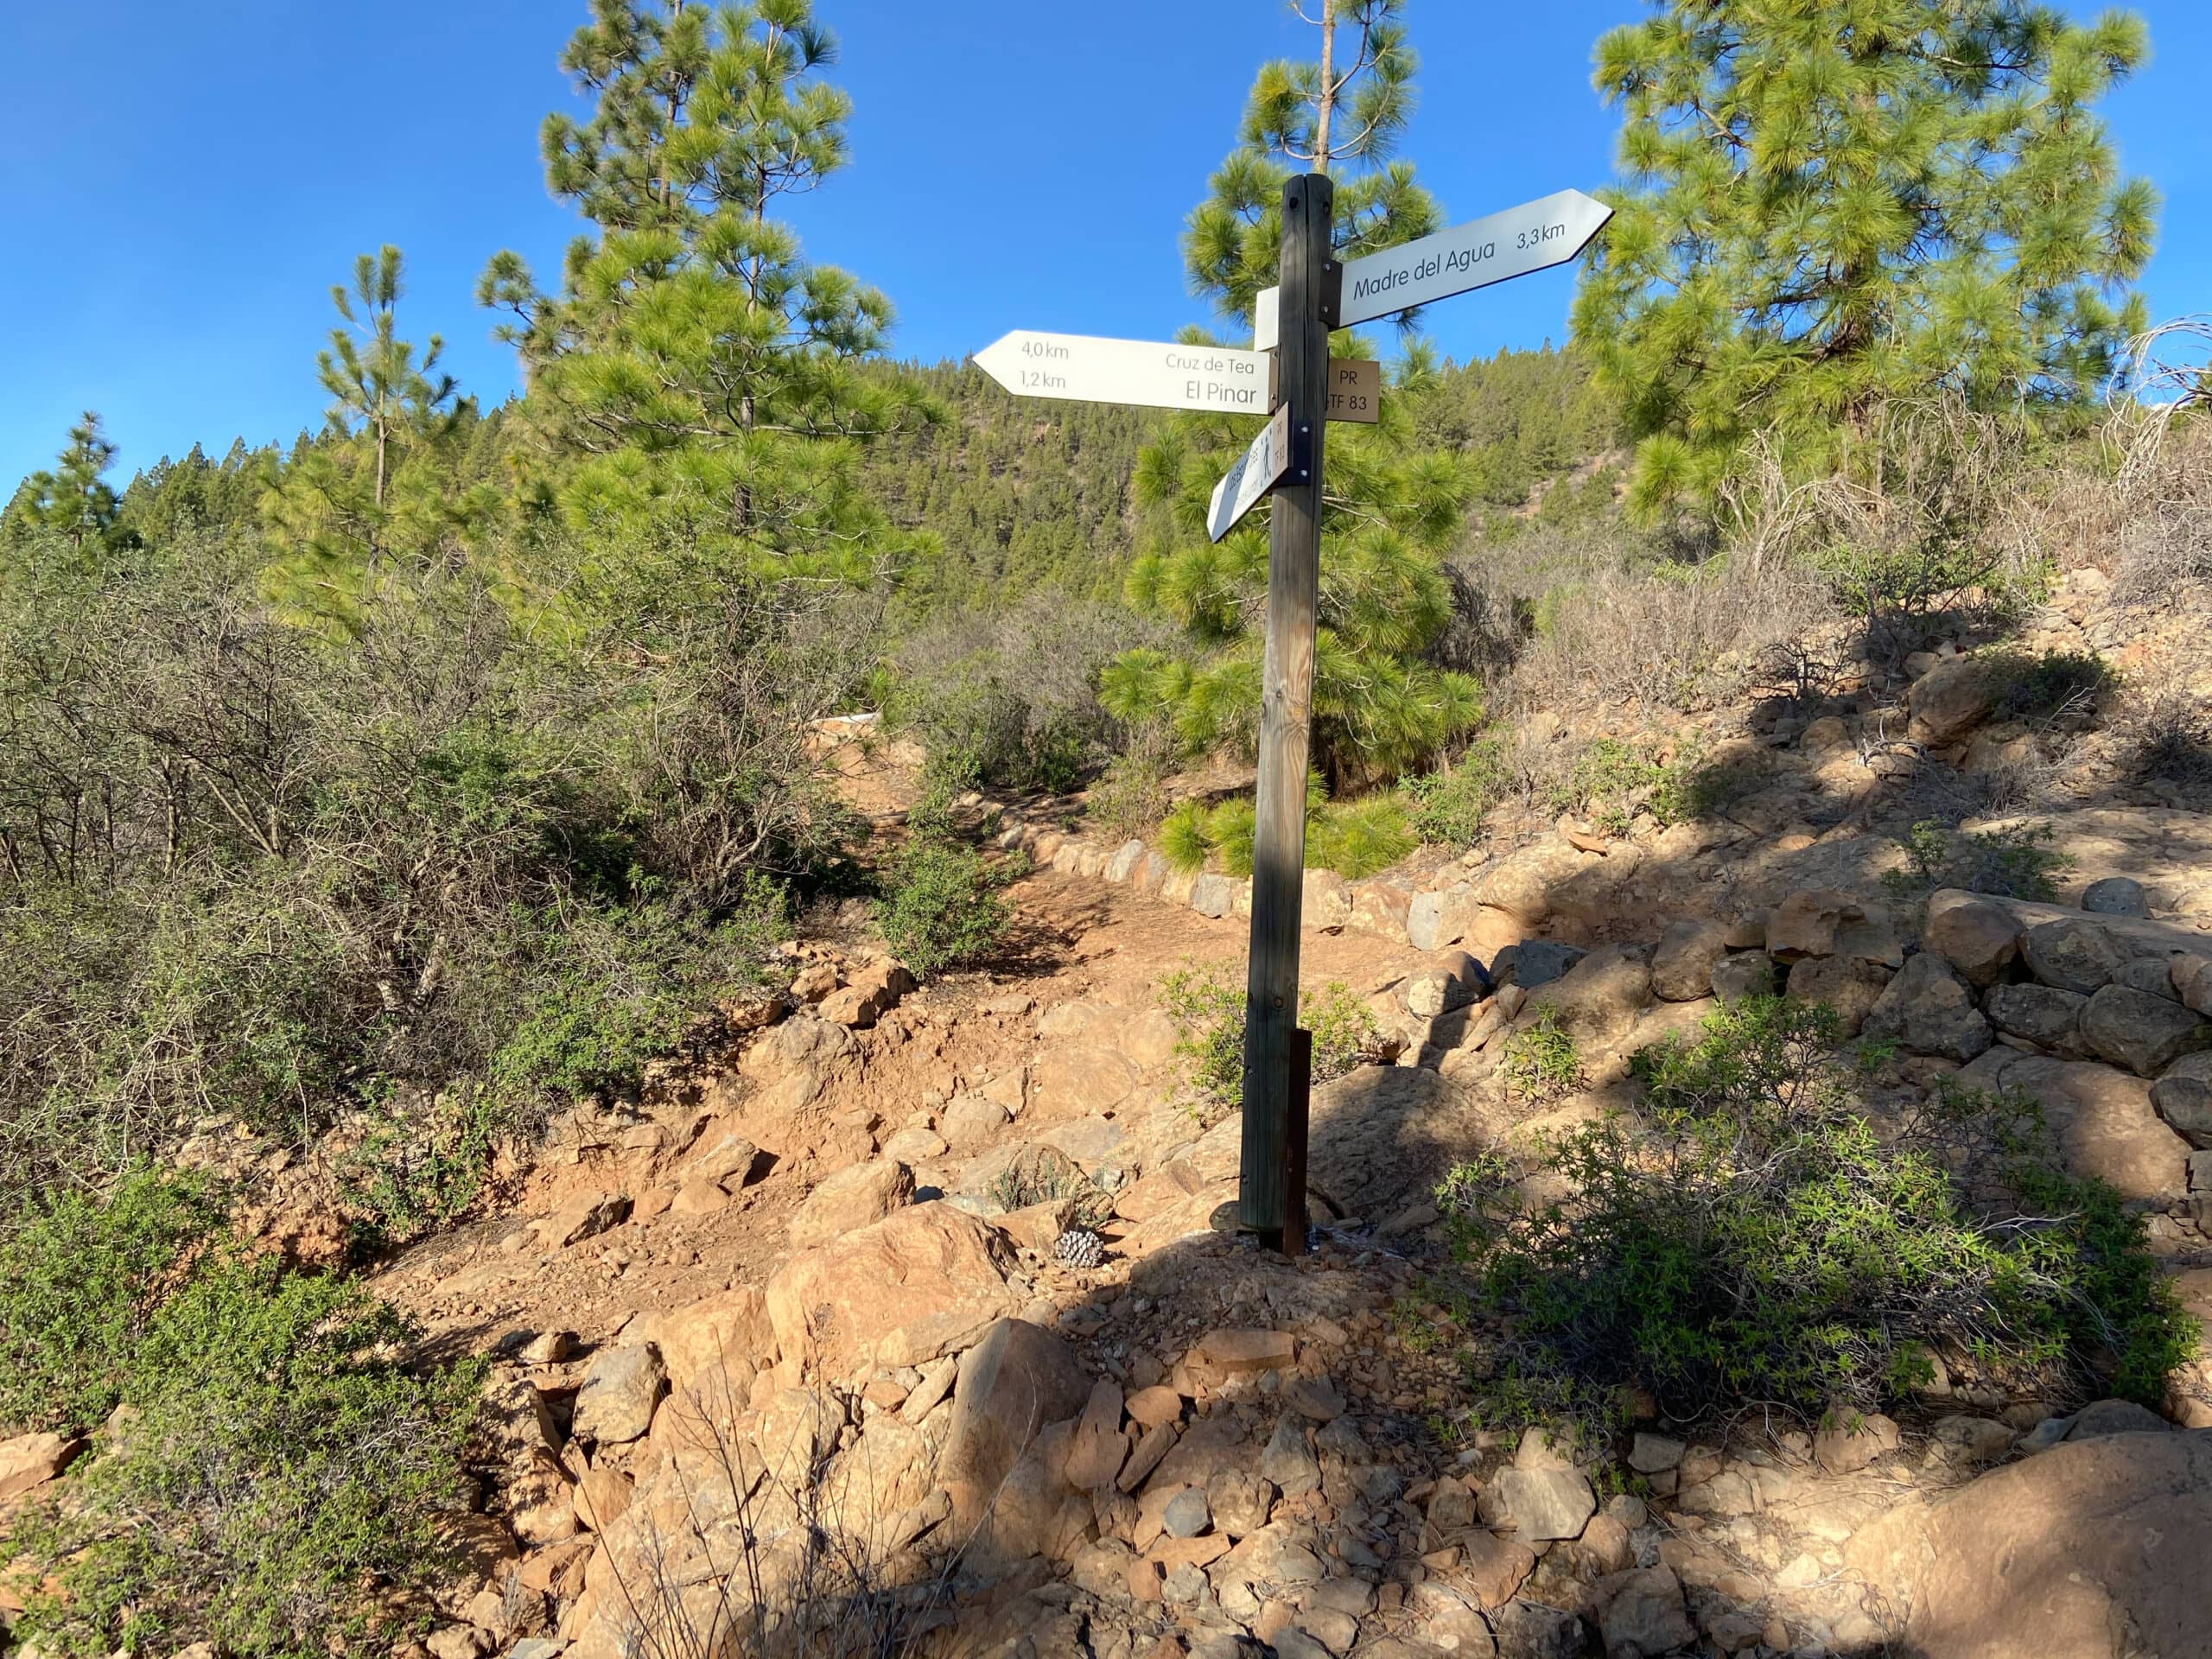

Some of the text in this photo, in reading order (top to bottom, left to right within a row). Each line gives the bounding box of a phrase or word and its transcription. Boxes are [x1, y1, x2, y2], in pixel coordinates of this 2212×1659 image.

[1516, 224, 1565, 251] 3,3 km
[1354, 241, 1495, 301] Madre del Agua
[1021, 340, 1069, 359] 4,0 km
[1166, 353, 1255, 374] Cruz de Tea
[1020, 370, 1065, 389] 1,2 km
[1340, 370, 1357, 385] PR
[1186, 379, 1257, 404] El Pinar
[1349, 395, 1367, 410] 83
